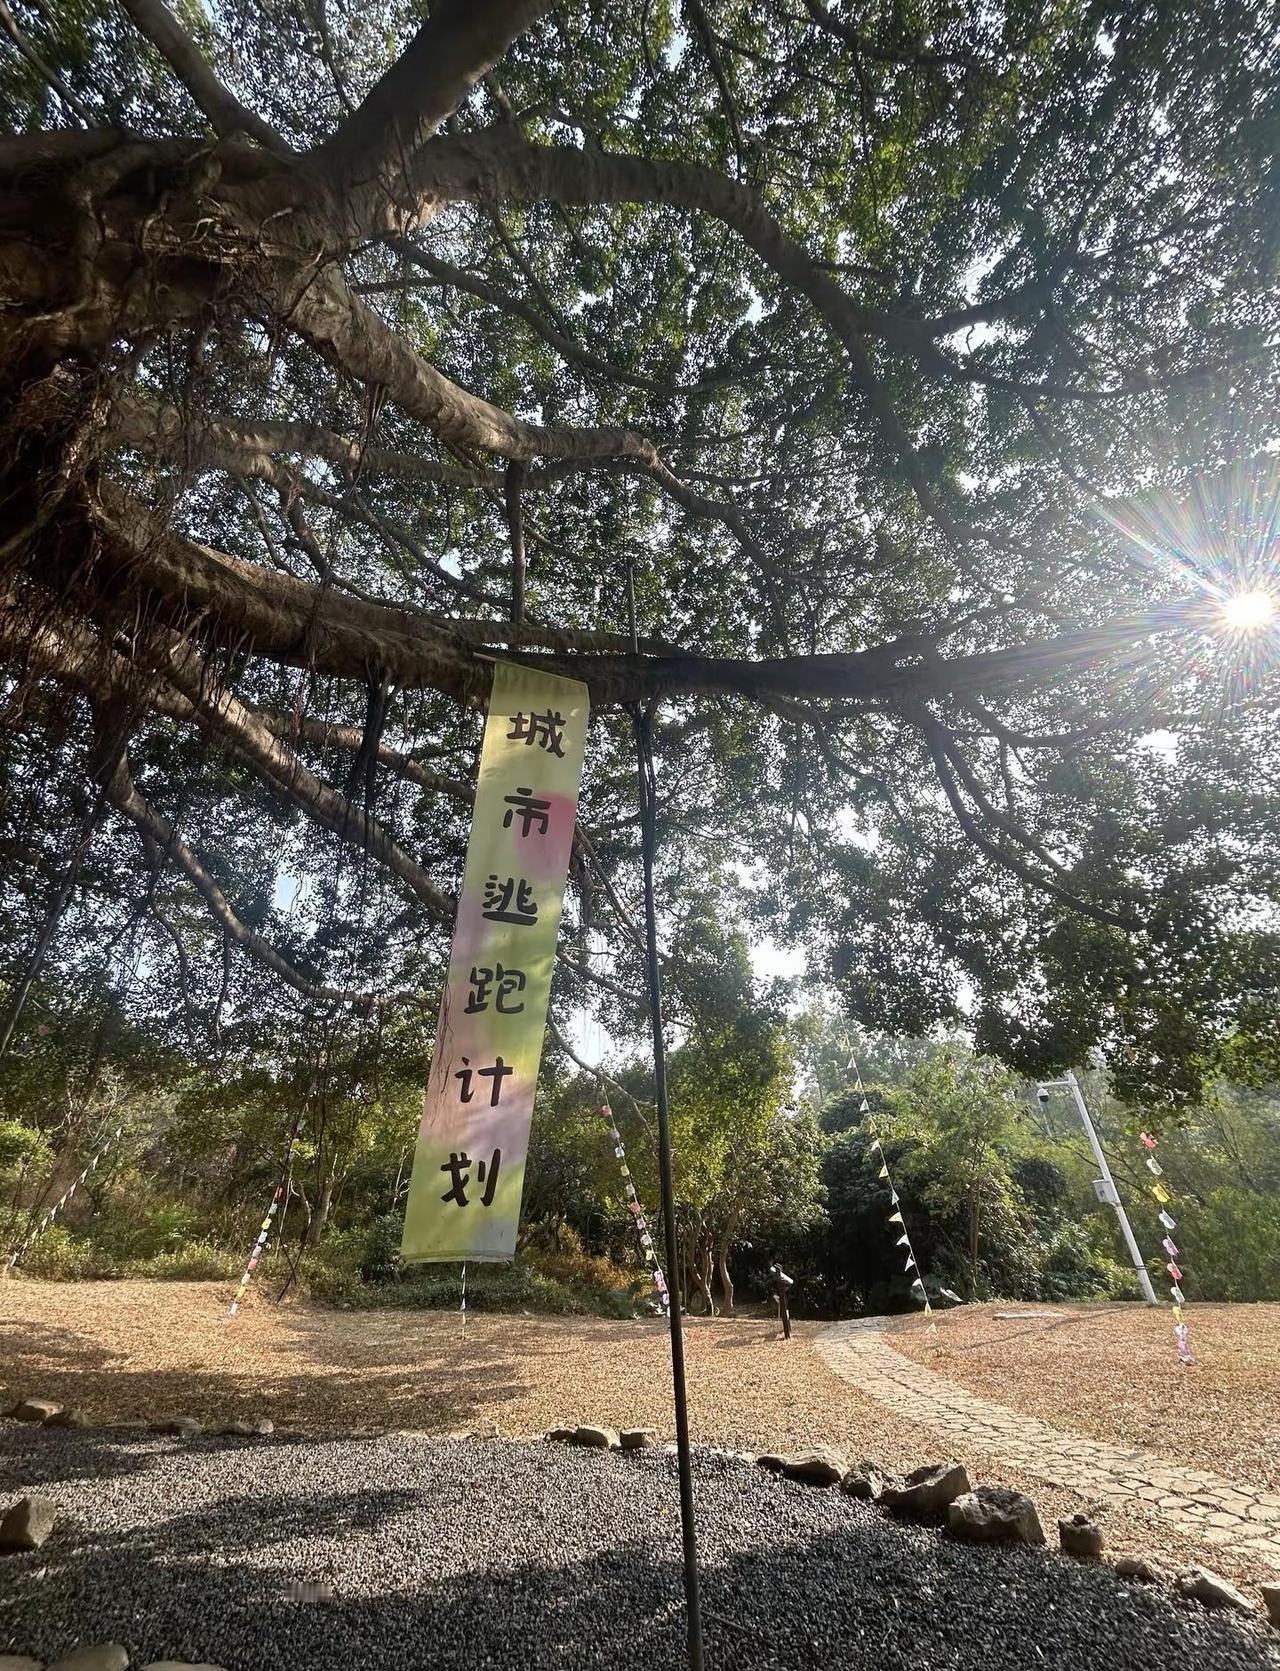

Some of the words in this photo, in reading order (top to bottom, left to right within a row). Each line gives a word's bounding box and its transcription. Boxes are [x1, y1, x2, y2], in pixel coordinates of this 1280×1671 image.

[441, 708, 566, 1208] 城市逃跑计划
